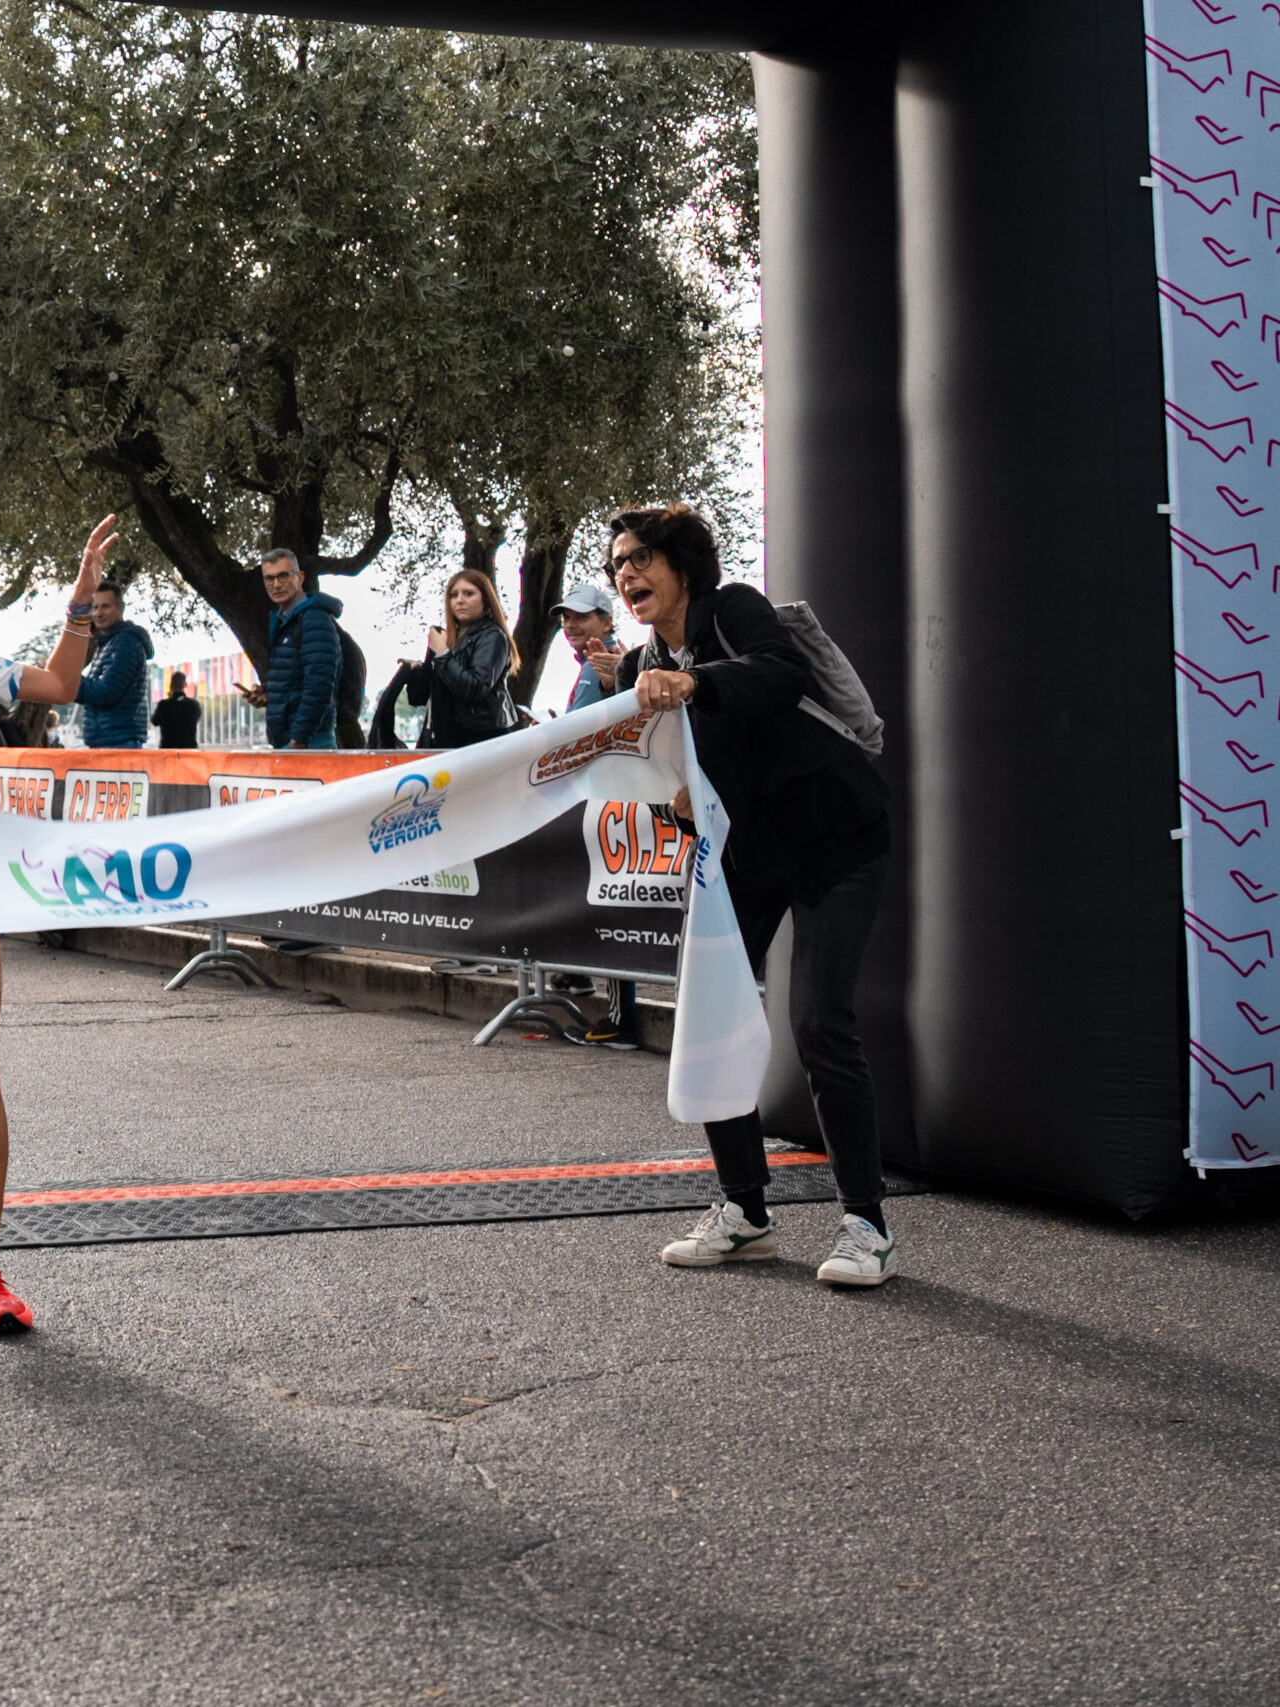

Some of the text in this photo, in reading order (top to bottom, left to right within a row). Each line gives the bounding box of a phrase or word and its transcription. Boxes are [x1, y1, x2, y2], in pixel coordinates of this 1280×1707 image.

[369, 818, 443, 854] VERONA
[8, 843, 192, 906] LA10
[321, 904, 340, 917] AD
[343, 906, 362, 920] UN
[364, 908, 410, 924] ALTRO
